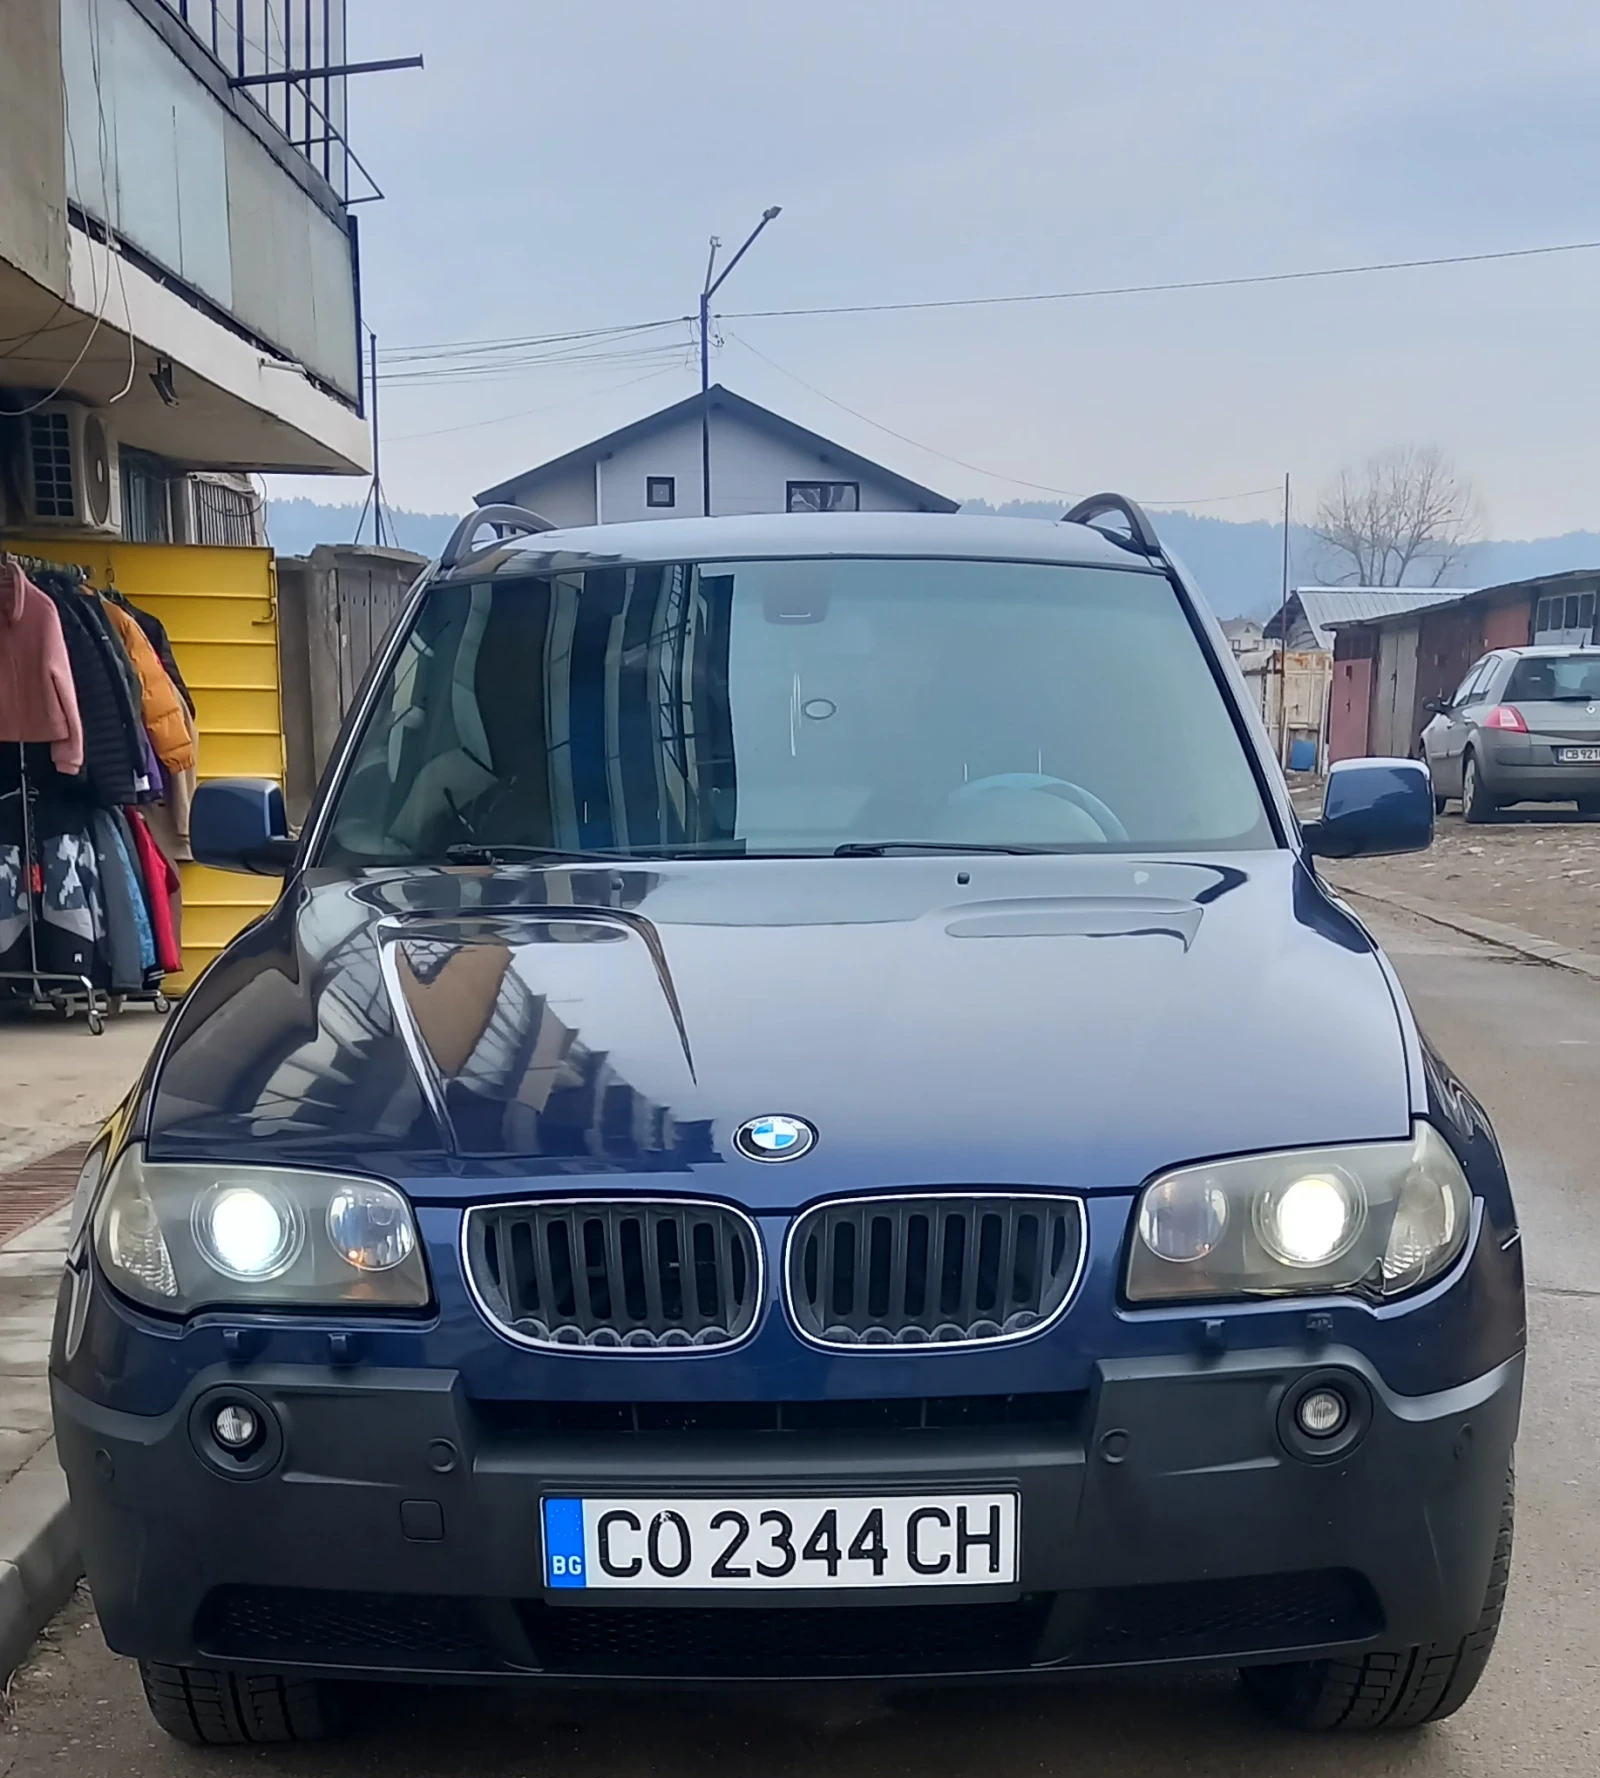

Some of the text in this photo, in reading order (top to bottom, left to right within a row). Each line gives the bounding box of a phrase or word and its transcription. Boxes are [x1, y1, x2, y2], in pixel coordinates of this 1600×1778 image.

[1565, 749, 1600, 759] CB 921
[598, 1504, 1001, 1578] CO 2344 CH
[552, 1555, 583, 1576] BG
